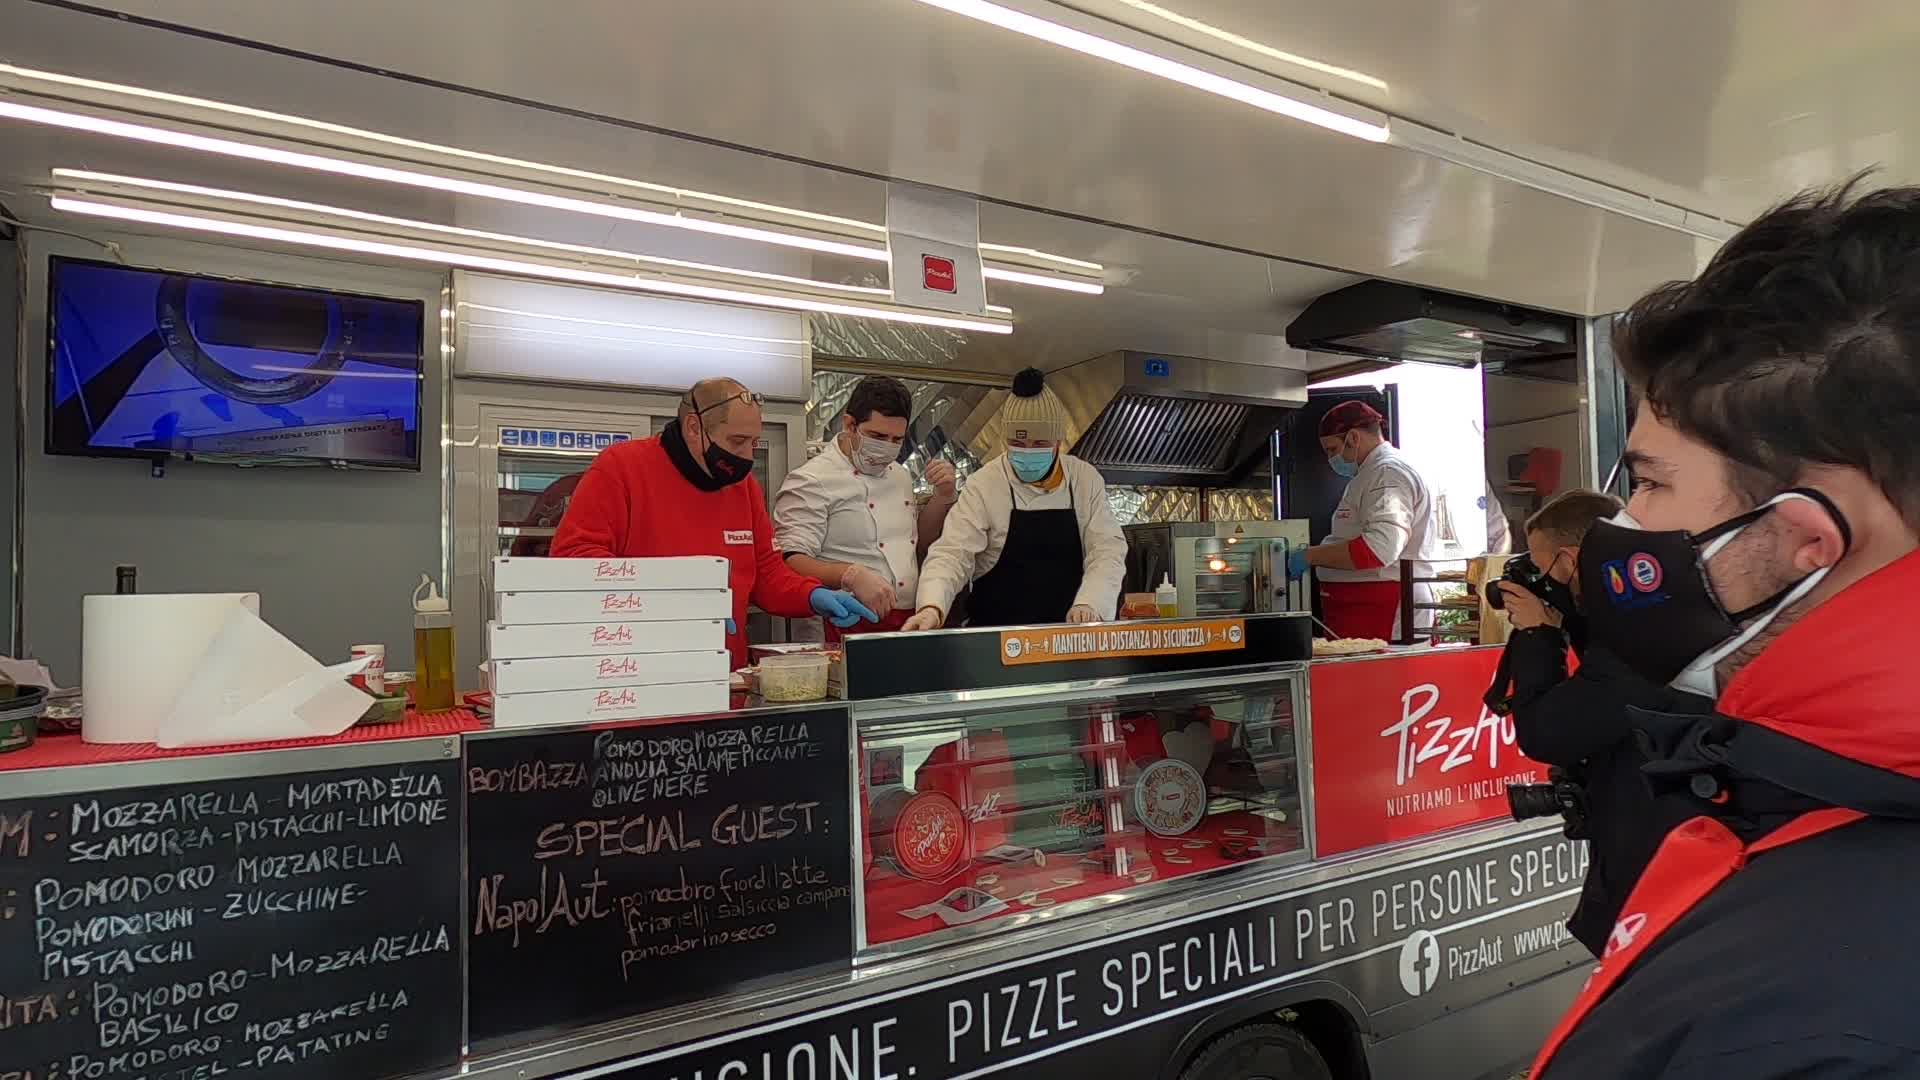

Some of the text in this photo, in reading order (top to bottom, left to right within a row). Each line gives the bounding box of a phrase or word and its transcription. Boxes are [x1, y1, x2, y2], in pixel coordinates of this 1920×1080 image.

[1052, 631, 1096, 655] MANTIENI
[1098, 631, 1110, 653] LA
[1111, 628, 1151, 652] DISTANZA
[1153, 629, 1162, 649] DI
[1163, 627, 1206, 650] SICUREZZA
[1380, 671, 1525, 786] PizzAu
[468, 759, 589, 793] BOMBAZZA
[742, 741, 822, 767] PICCANTE
[71, 791, 260, 835] MOZZARELLA
[287, 773, 442, 810] MORTADELLA
[592, 774, 709, 806] OLIVE NERE
[1386, 787, 1452, 817] NUTRIAMO
[69, 826, 214, 862] SCAMORZA
[534, 810, 701, 859] SPECIAL
[35, 842, 402, 915] POMODORO MOZZARELLA
[36, 907, 194, 953] POMODORINI
[43, 941, 194, 980] PISTACCHI
[948, 969, 1078, 1063] PIZZE
[1101, 917, 1278, 1016] SPECIALI
[1296, 897, 1357, 960] PER
[1372, 860, 1499, 937] PERSONE
[1448, 936, 1503, 980] PizzAut
[99, 1002, 240, 1049] BASILICO
[244, 988, 410, 1042] MOZZARELLA
